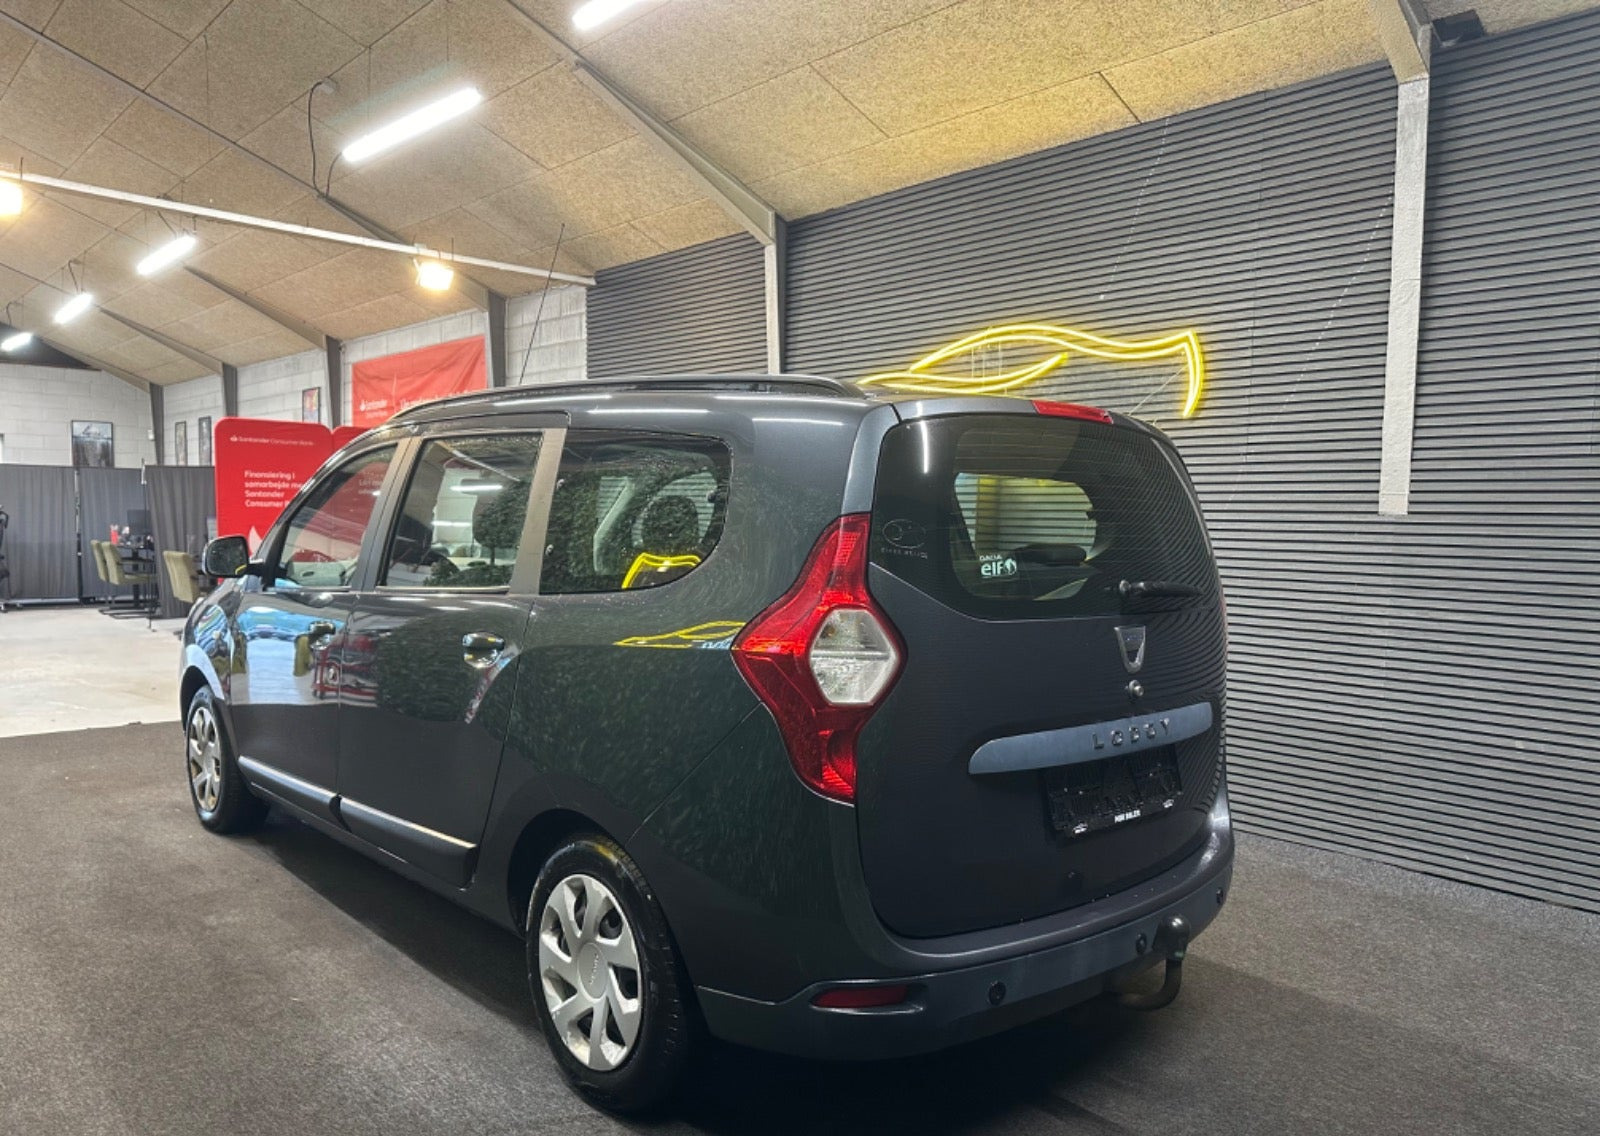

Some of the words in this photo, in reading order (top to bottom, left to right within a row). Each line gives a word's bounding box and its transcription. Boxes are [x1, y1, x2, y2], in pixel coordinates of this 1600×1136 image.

[244, 470, 292, 480] Finansiering
[244, 481, 290, 489] samarbejde
[244, 490, 285, 498] Santander
[244, 499, 284, 508] Consumer
[1091, 717, 1170, 750] LODGY
